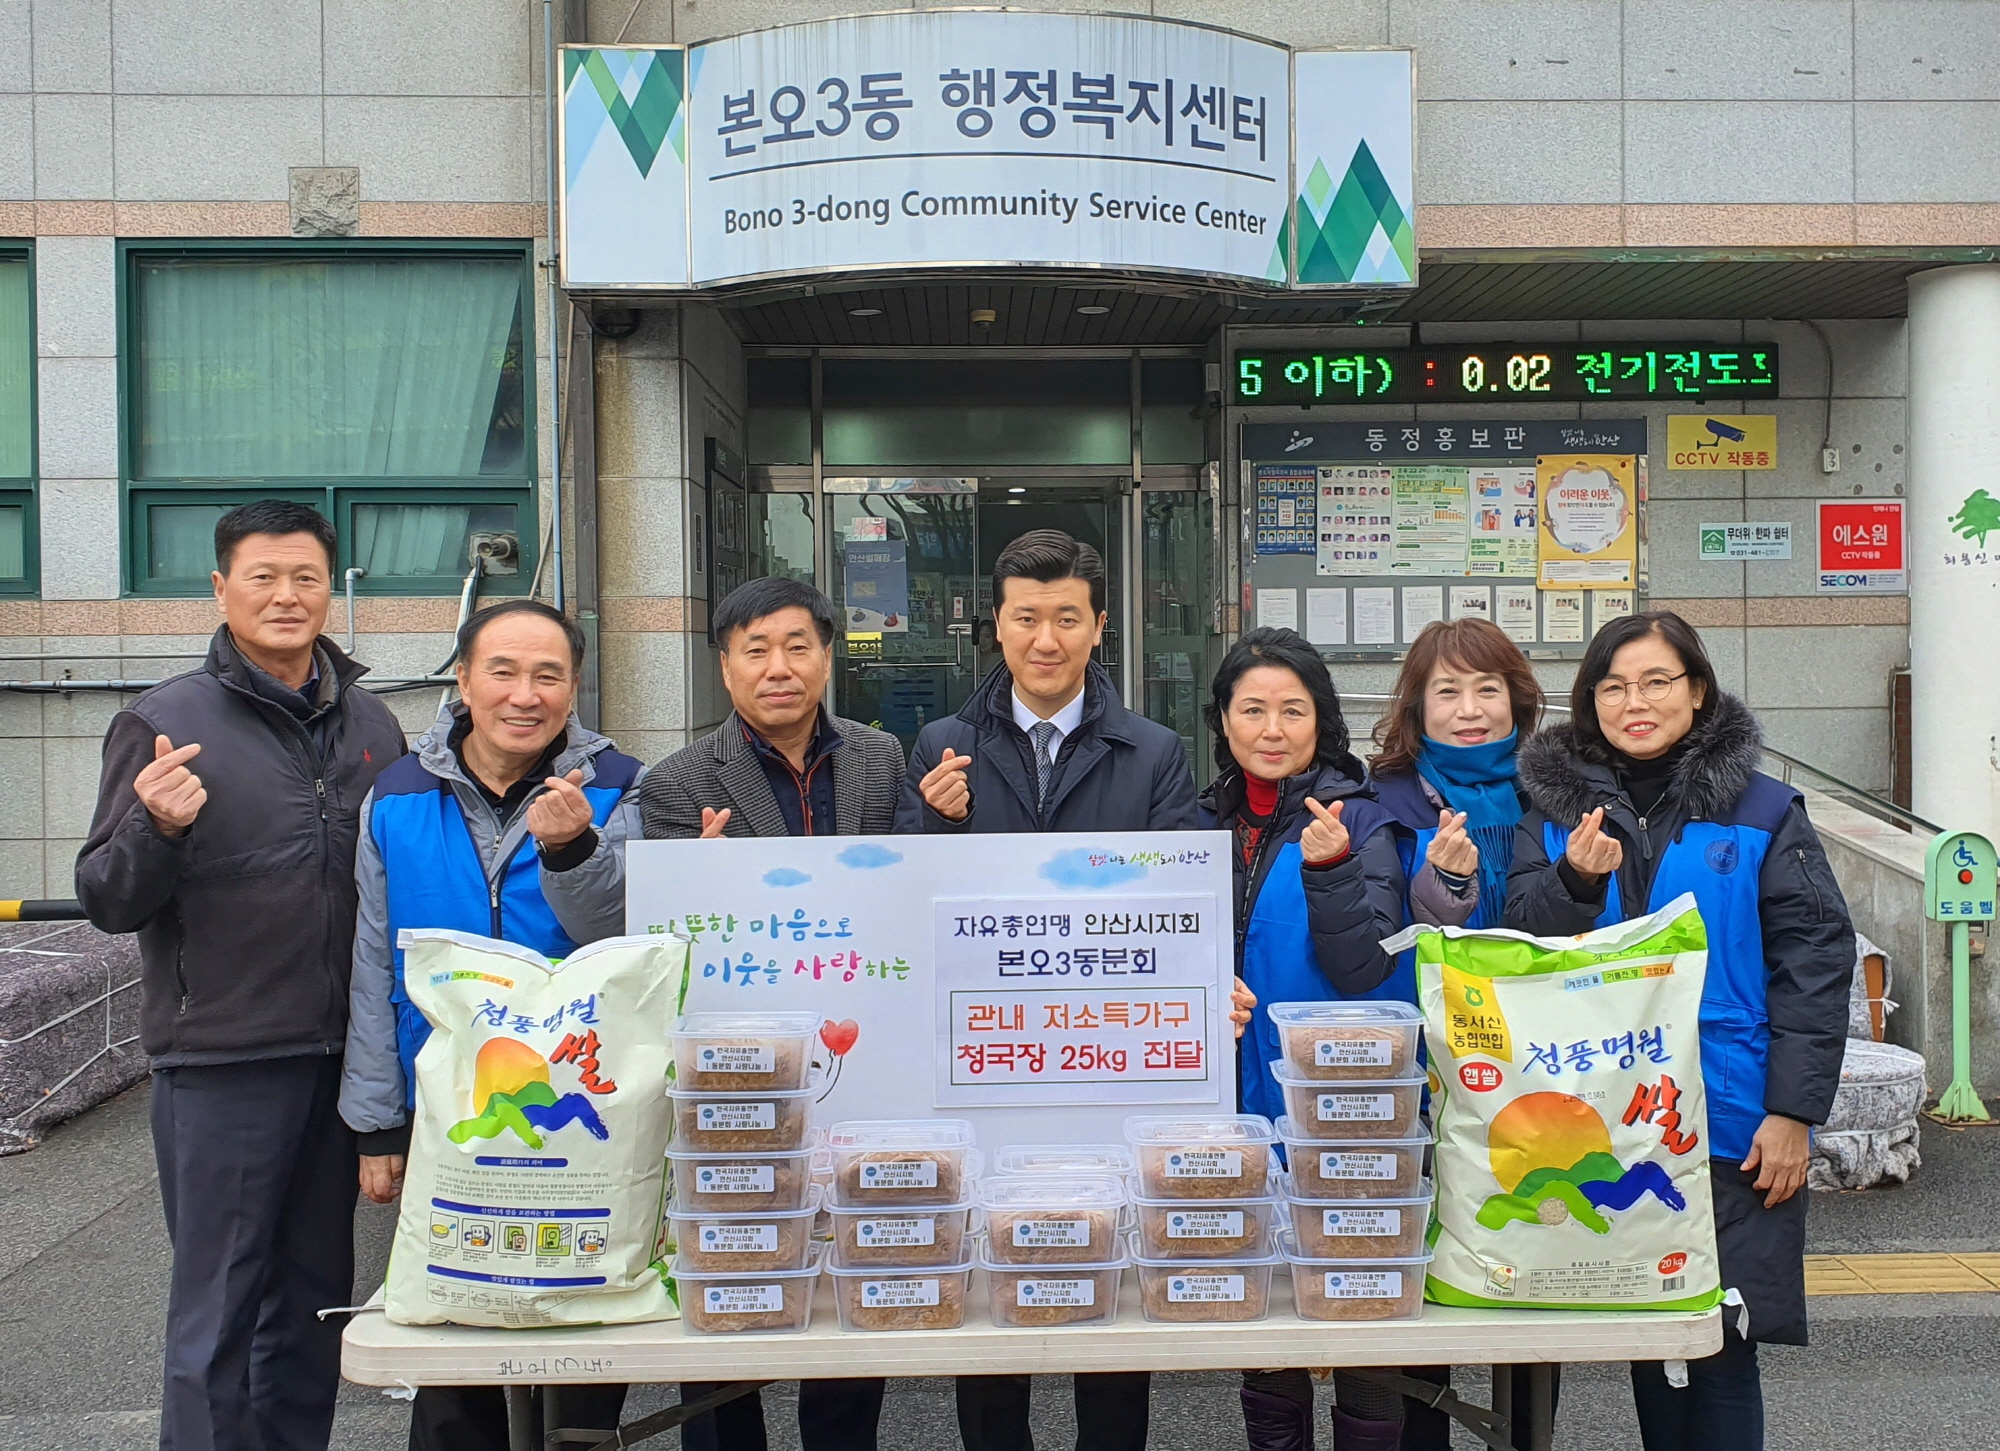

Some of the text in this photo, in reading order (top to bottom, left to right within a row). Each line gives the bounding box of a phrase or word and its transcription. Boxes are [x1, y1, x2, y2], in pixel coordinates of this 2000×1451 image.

[717, 67, 1268, 162] 본오3동 행정복지센터
[723, 190, 1267, 236] Bono 3-dong Community Service Center
[1240, 360, 1262, 395] 5
[1284, 355, 1393, 397] 이하)
[1462, 355, 1550, 393] 0.02
[1675, 451, 1770, 466] CCTV 작동중
[1560, 489, 1612, 500] 어려운 이웃,
[1727, 526, 1789, 540] 무더위·한파 쉼터
[1832, 524, 1888, 546] 에스원
[1821, 575, 1867, 586] SECOM
[1109, 854, 1126, 866] 나는
[1178, 849, 1211, 865] 안산
[1711, 851, 1736, 863] KFF
[1940, 900, 1993, 914] 도움벨
[749, 908, 854, 942] 마음으로
[953, 912, 1201, 939] 자유총연맹 안산시지회
[703, 950, 911, 987] 이웃을 사랑하는
[997, 947, 1157, 978] 본오3동분회
[1606, 971, 1629, 980] 기름진
[471, 993, 601, 1034] 청풍명월
[967, 1001, 1190, 1032] 관내 저소득가구
[1454, 1031, 1504, 1050] 농협연합
[1522, 1026, 1673, 1075] 청풍명월
[548, 1028, 618, 1094] 쌀
[956, 1040, 1204, 1074] 청국장 25kg 전달
[1621, 1074, 1699, 1156] 쌀
[1660, 1257, 1684, 1269] 20 kg
